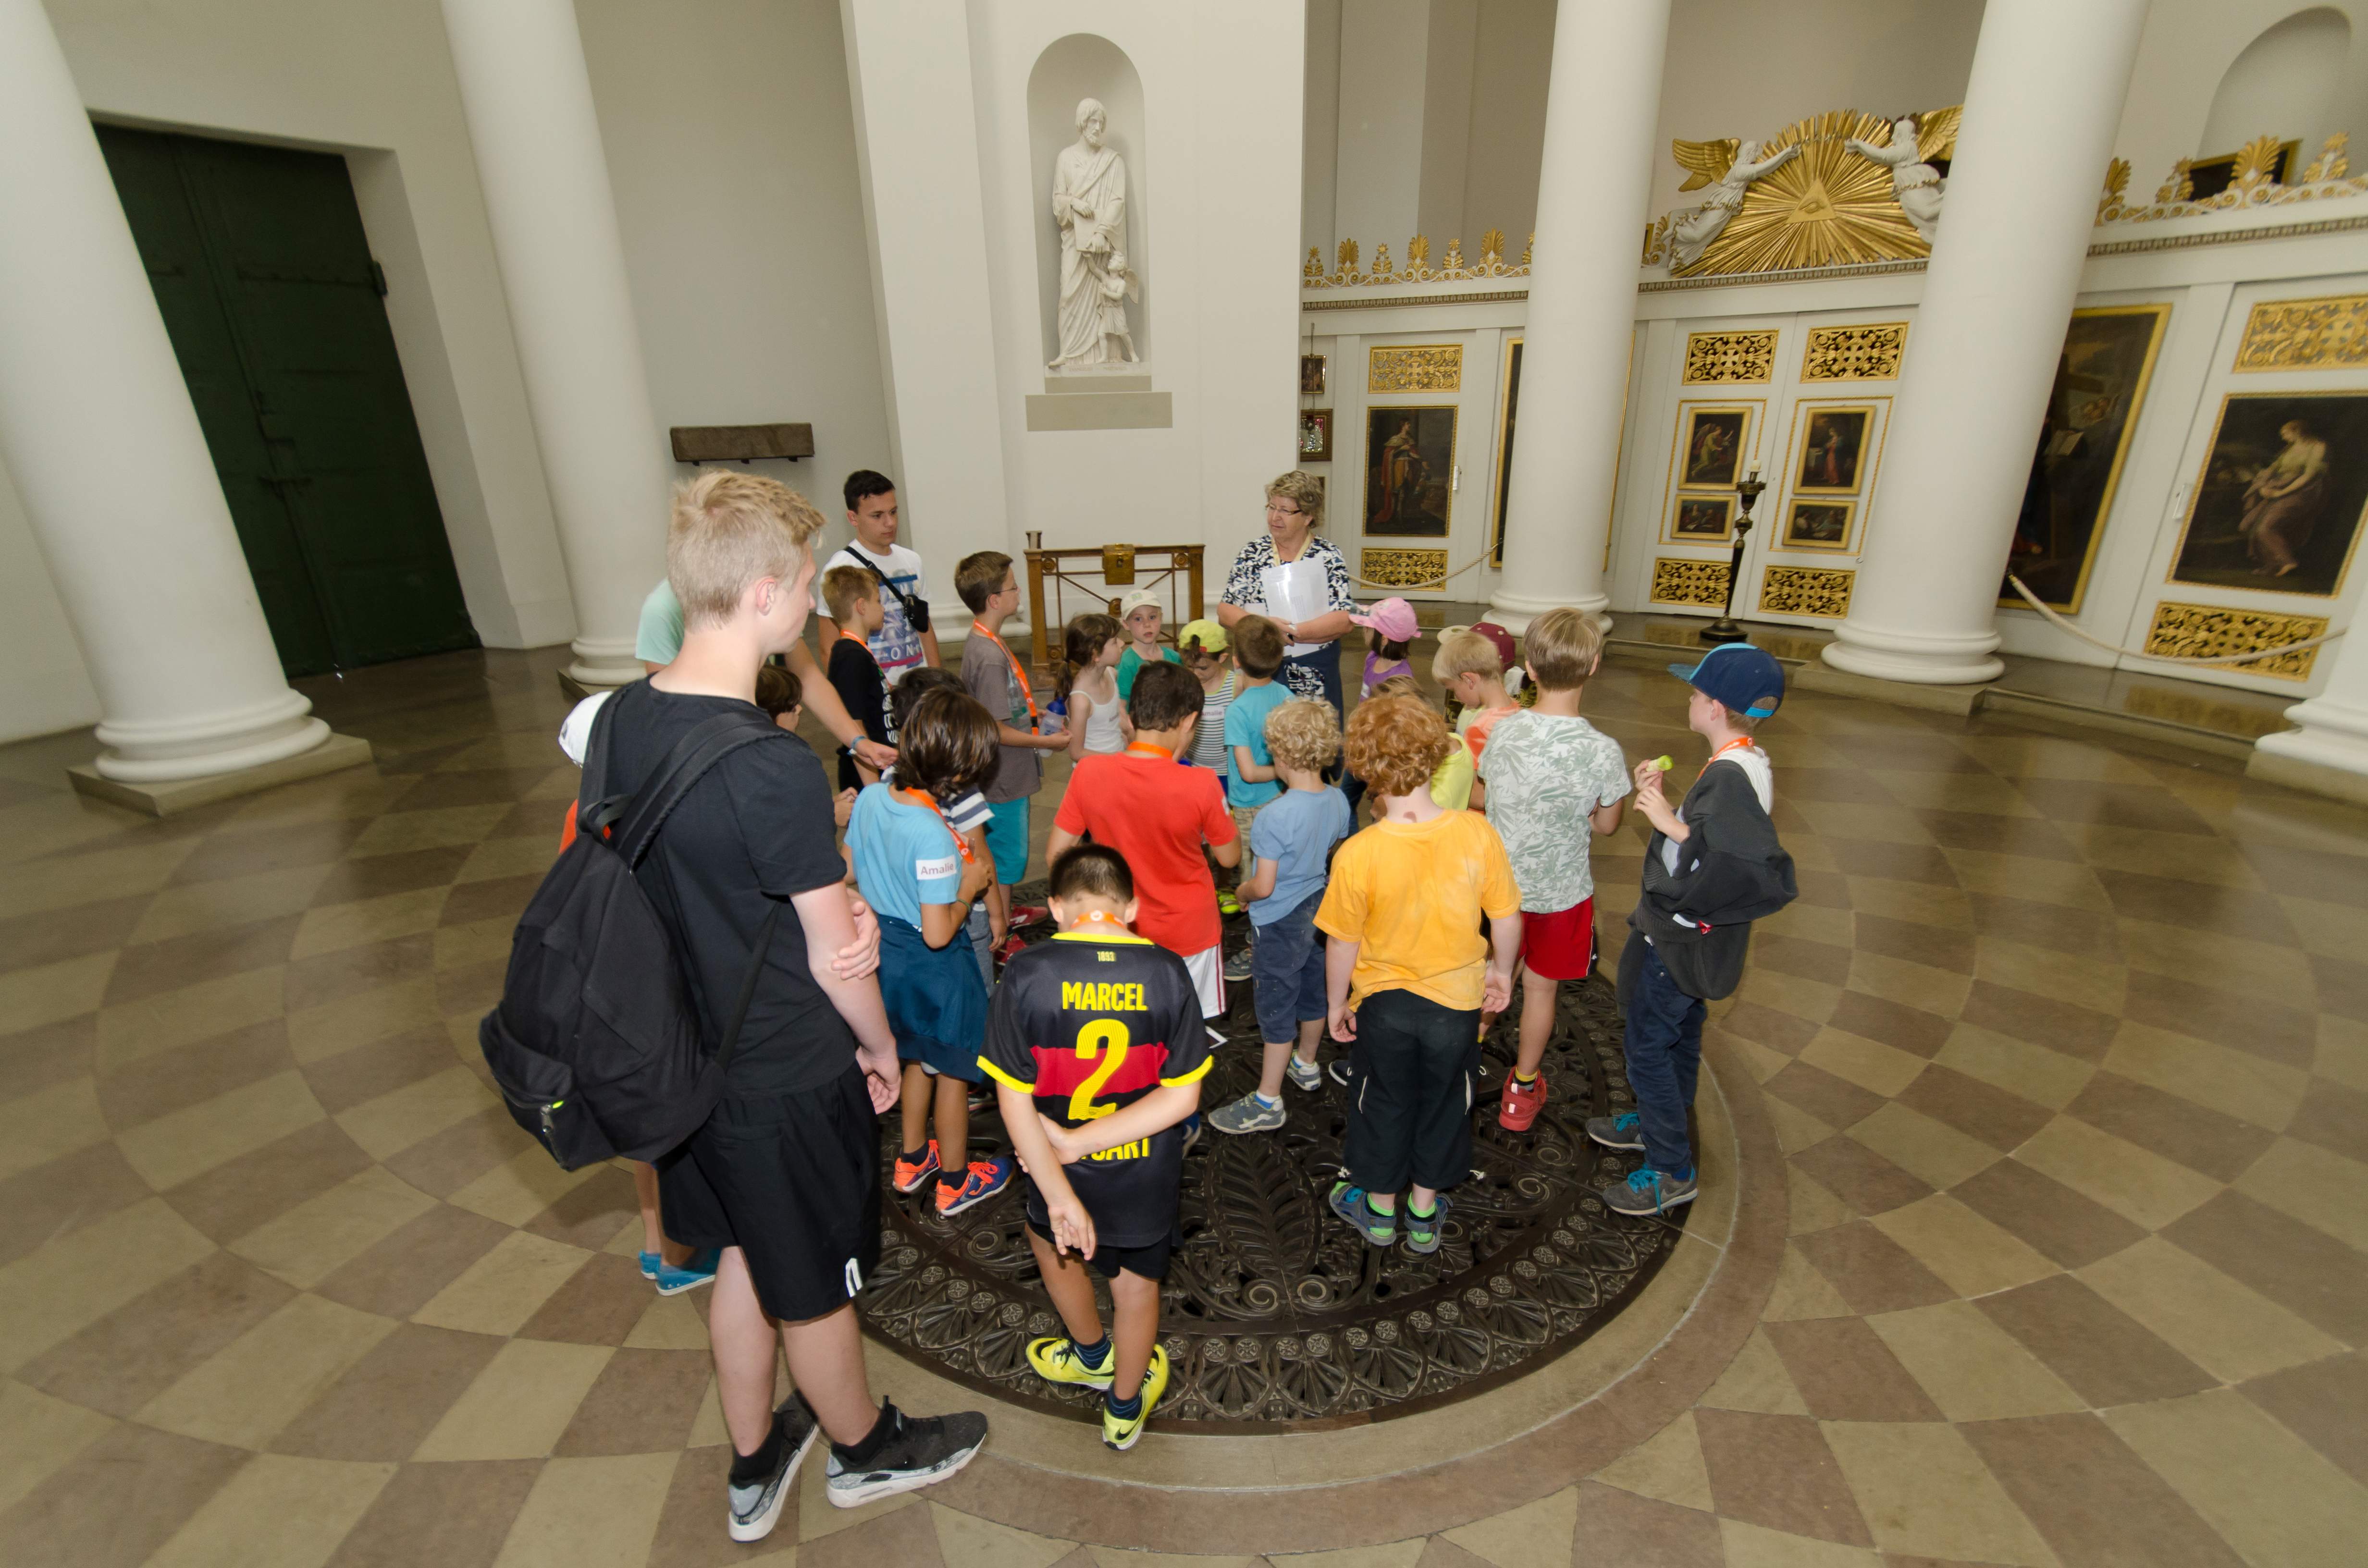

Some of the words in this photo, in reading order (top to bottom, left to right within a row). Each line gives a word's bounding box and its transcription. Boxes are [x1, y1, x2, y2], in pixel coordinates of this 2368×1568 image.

[921, 863, 953, 875] Amalie
[1097, 951, 1116, 962] 1893
[1062, 981, 1147, 1011] MARCEL
[1068, 1018, 1129, 1120] 2
